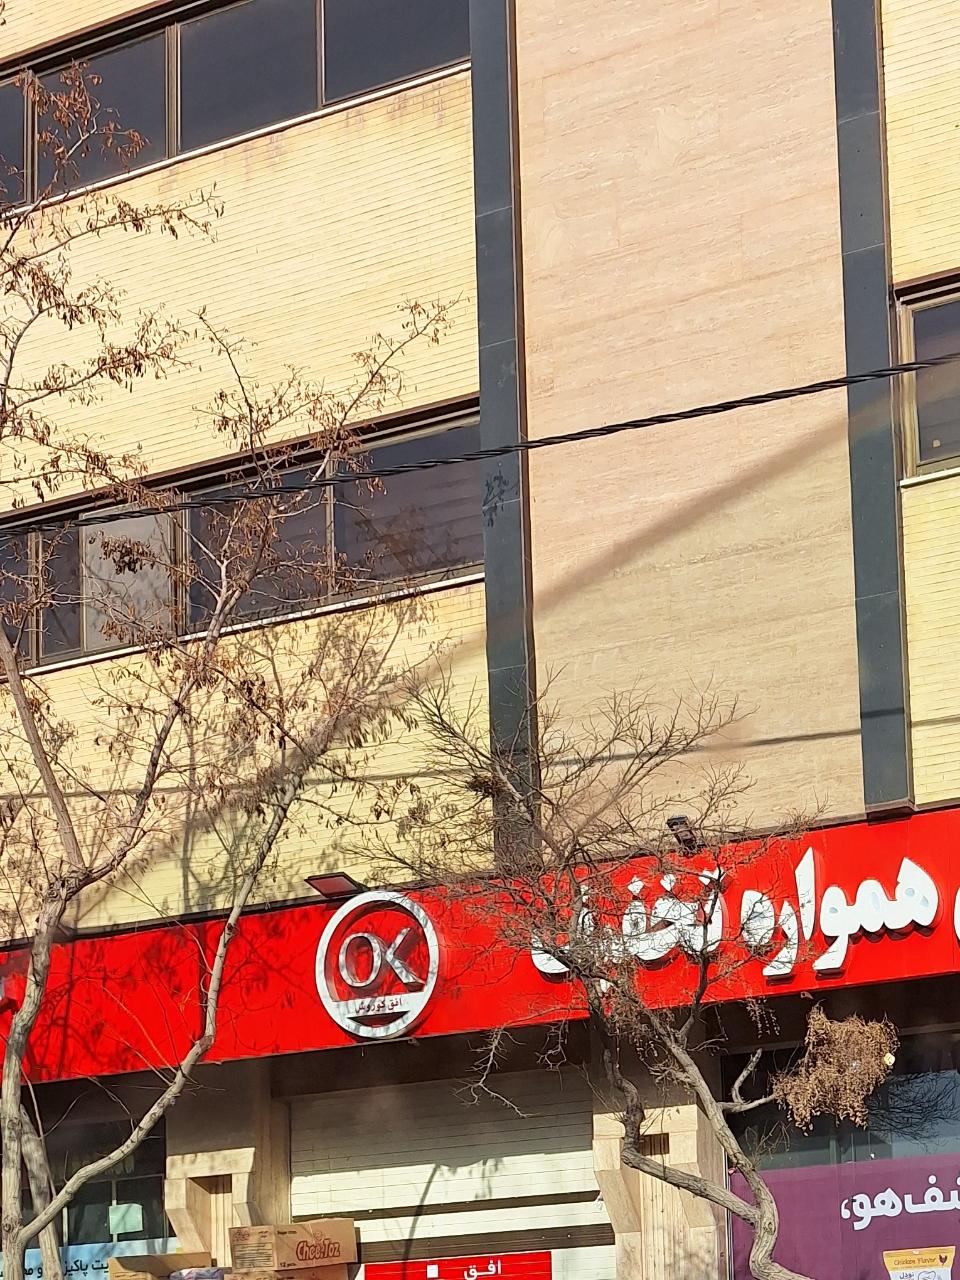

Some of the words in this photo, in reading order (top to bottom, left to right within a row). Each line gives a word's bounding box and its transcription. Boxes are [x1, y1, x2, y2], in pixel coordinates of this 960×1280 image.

[740, 846, 939, 978] همواره
[339, 927, 426, 988] OK
[354, 1000, 386, 1014] کوروش
[388, 998, 402, 1011] افق
